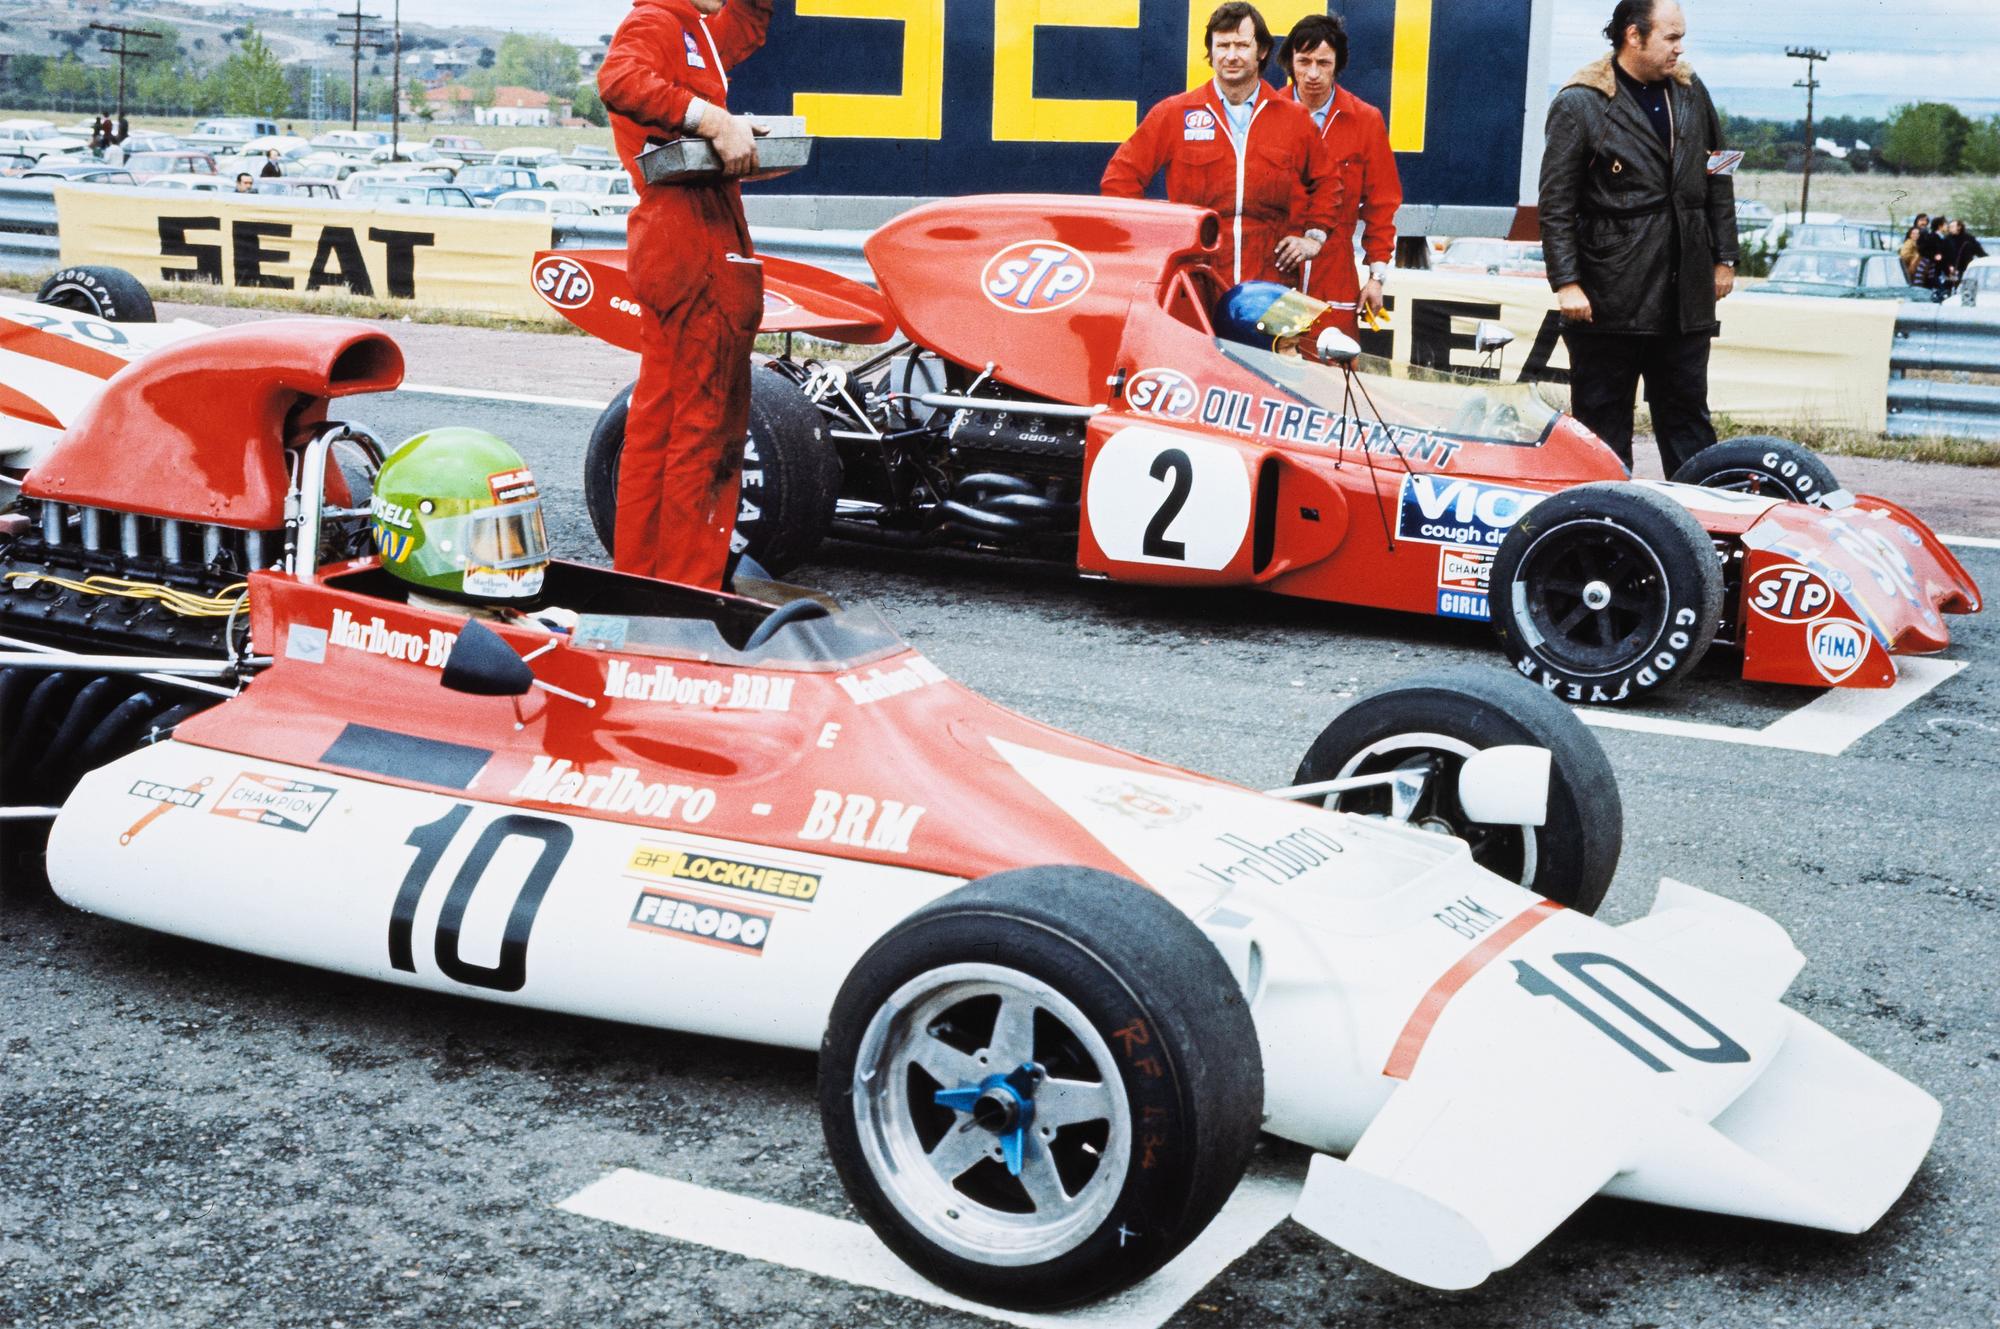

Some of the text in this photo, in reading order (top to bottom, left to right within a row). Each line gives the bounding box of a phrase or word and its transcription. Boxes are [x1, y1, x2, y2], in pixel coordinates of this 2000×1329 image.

[158, 216, 434, 299] SEAT
[537, 262, 589, 301] STP
[983, 248, 1070, 306] STP
[57, 269, 116, 318] GOODYE
[610, 296, 642, 317] GOO
[1018, 433, 1057, 443] FORD
[1132, 374, 1462, 470] STP OIL TREATMENT
[1142, 448, 1193, 561] 2
[1412, 474, 1549, 528] VIC
[1762, 452, 1822, 508] GOOD
[1421, 524, 1507, 544] cough dr
[1449, 562, 1487, 575] CHAMP
[1755, 570, 1827, 615] STP
[329, 608, 458, 668] Marlboro-B
[1517, 607, 1697, 702] GOODYEAR
[1818, 634, 1856, 659] FINA
[604, 658, 796, 712] Marlboro-BRM
[816, 722, 842, 749] E
[131, 780, 203, 807] KONI
[232, 788, 316, 813] CHAMPION
[509, 755, 716, 823] Marlboro
[797, 789, 926, 853] BRM
[388, 803, 574, 993] 10
[673, 855, 818, 900] LOCKHEED
[636, 895, 767, 945] FERODO
[1510, 952, 1751, 1072] 10
